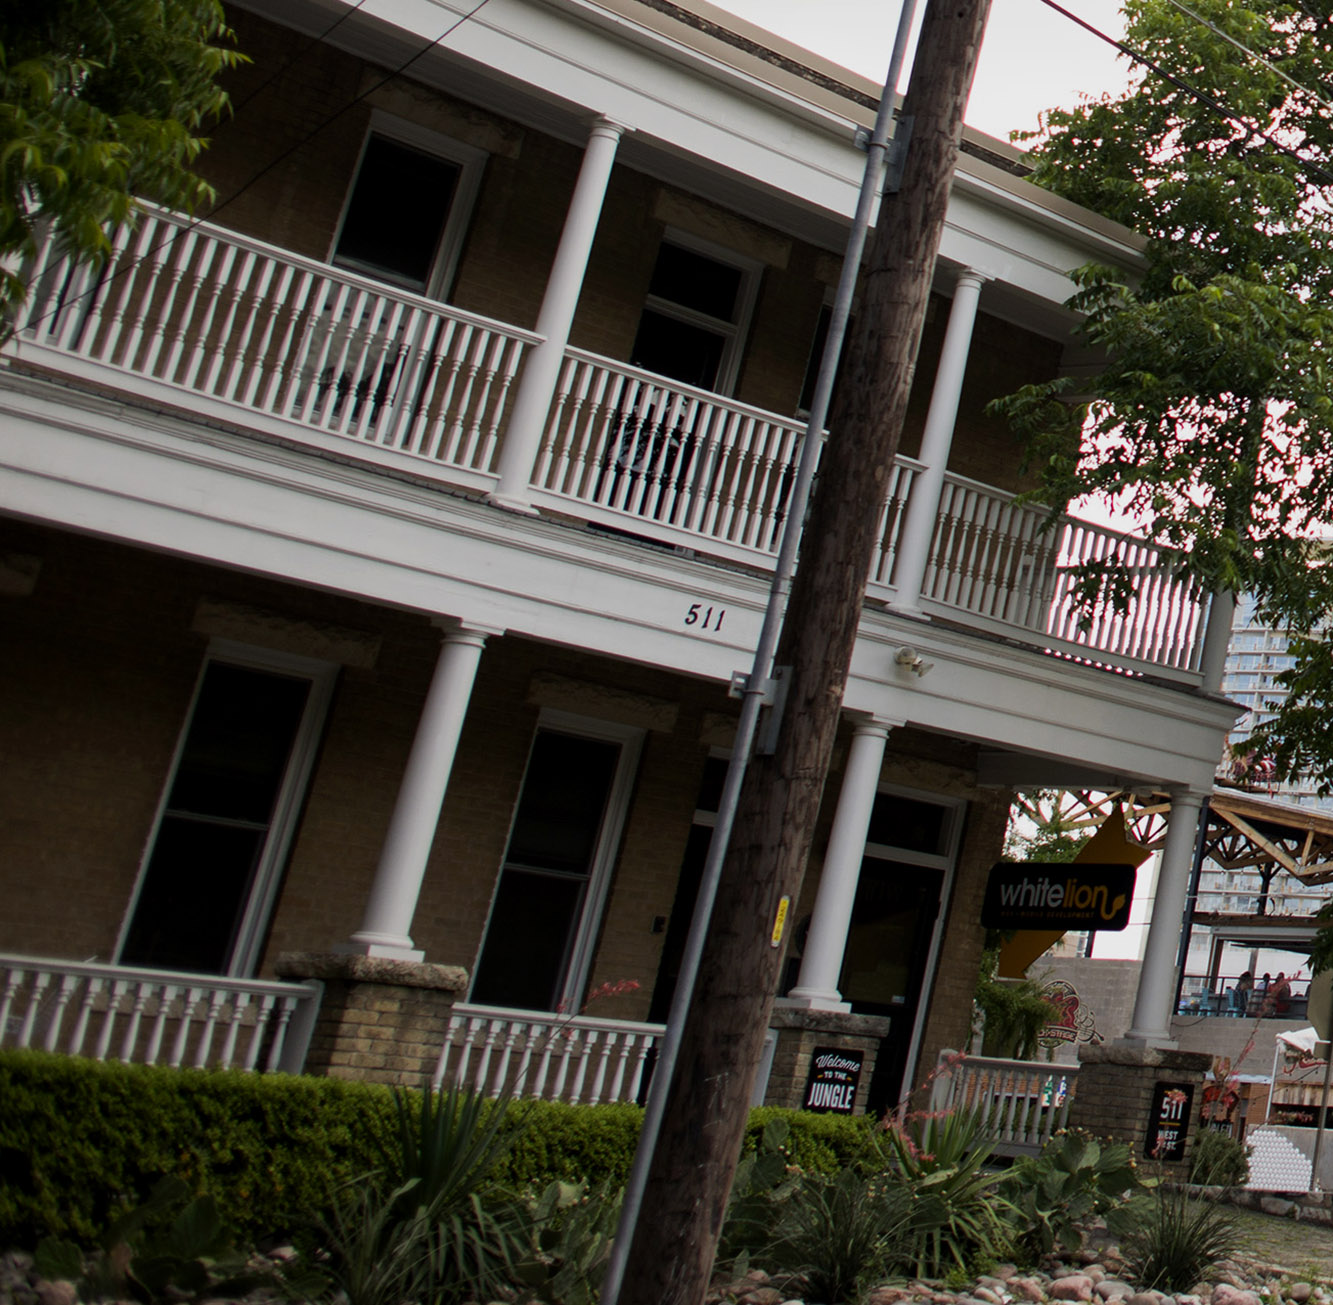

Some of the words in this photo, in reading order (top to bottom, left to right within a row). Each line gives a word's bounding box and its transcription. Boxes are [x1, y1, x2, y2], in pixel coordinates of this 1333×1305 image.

[684, 603, 726, 632] 511
[1000, 877, 1126, 920] whitelion
[815, 1053, 861, 1073] Welcome
[823, 1070, 834, 1080] TO
[834, 1070, 848, 1081] THE
[807, 1082, 855, 1110] JUNGLE
